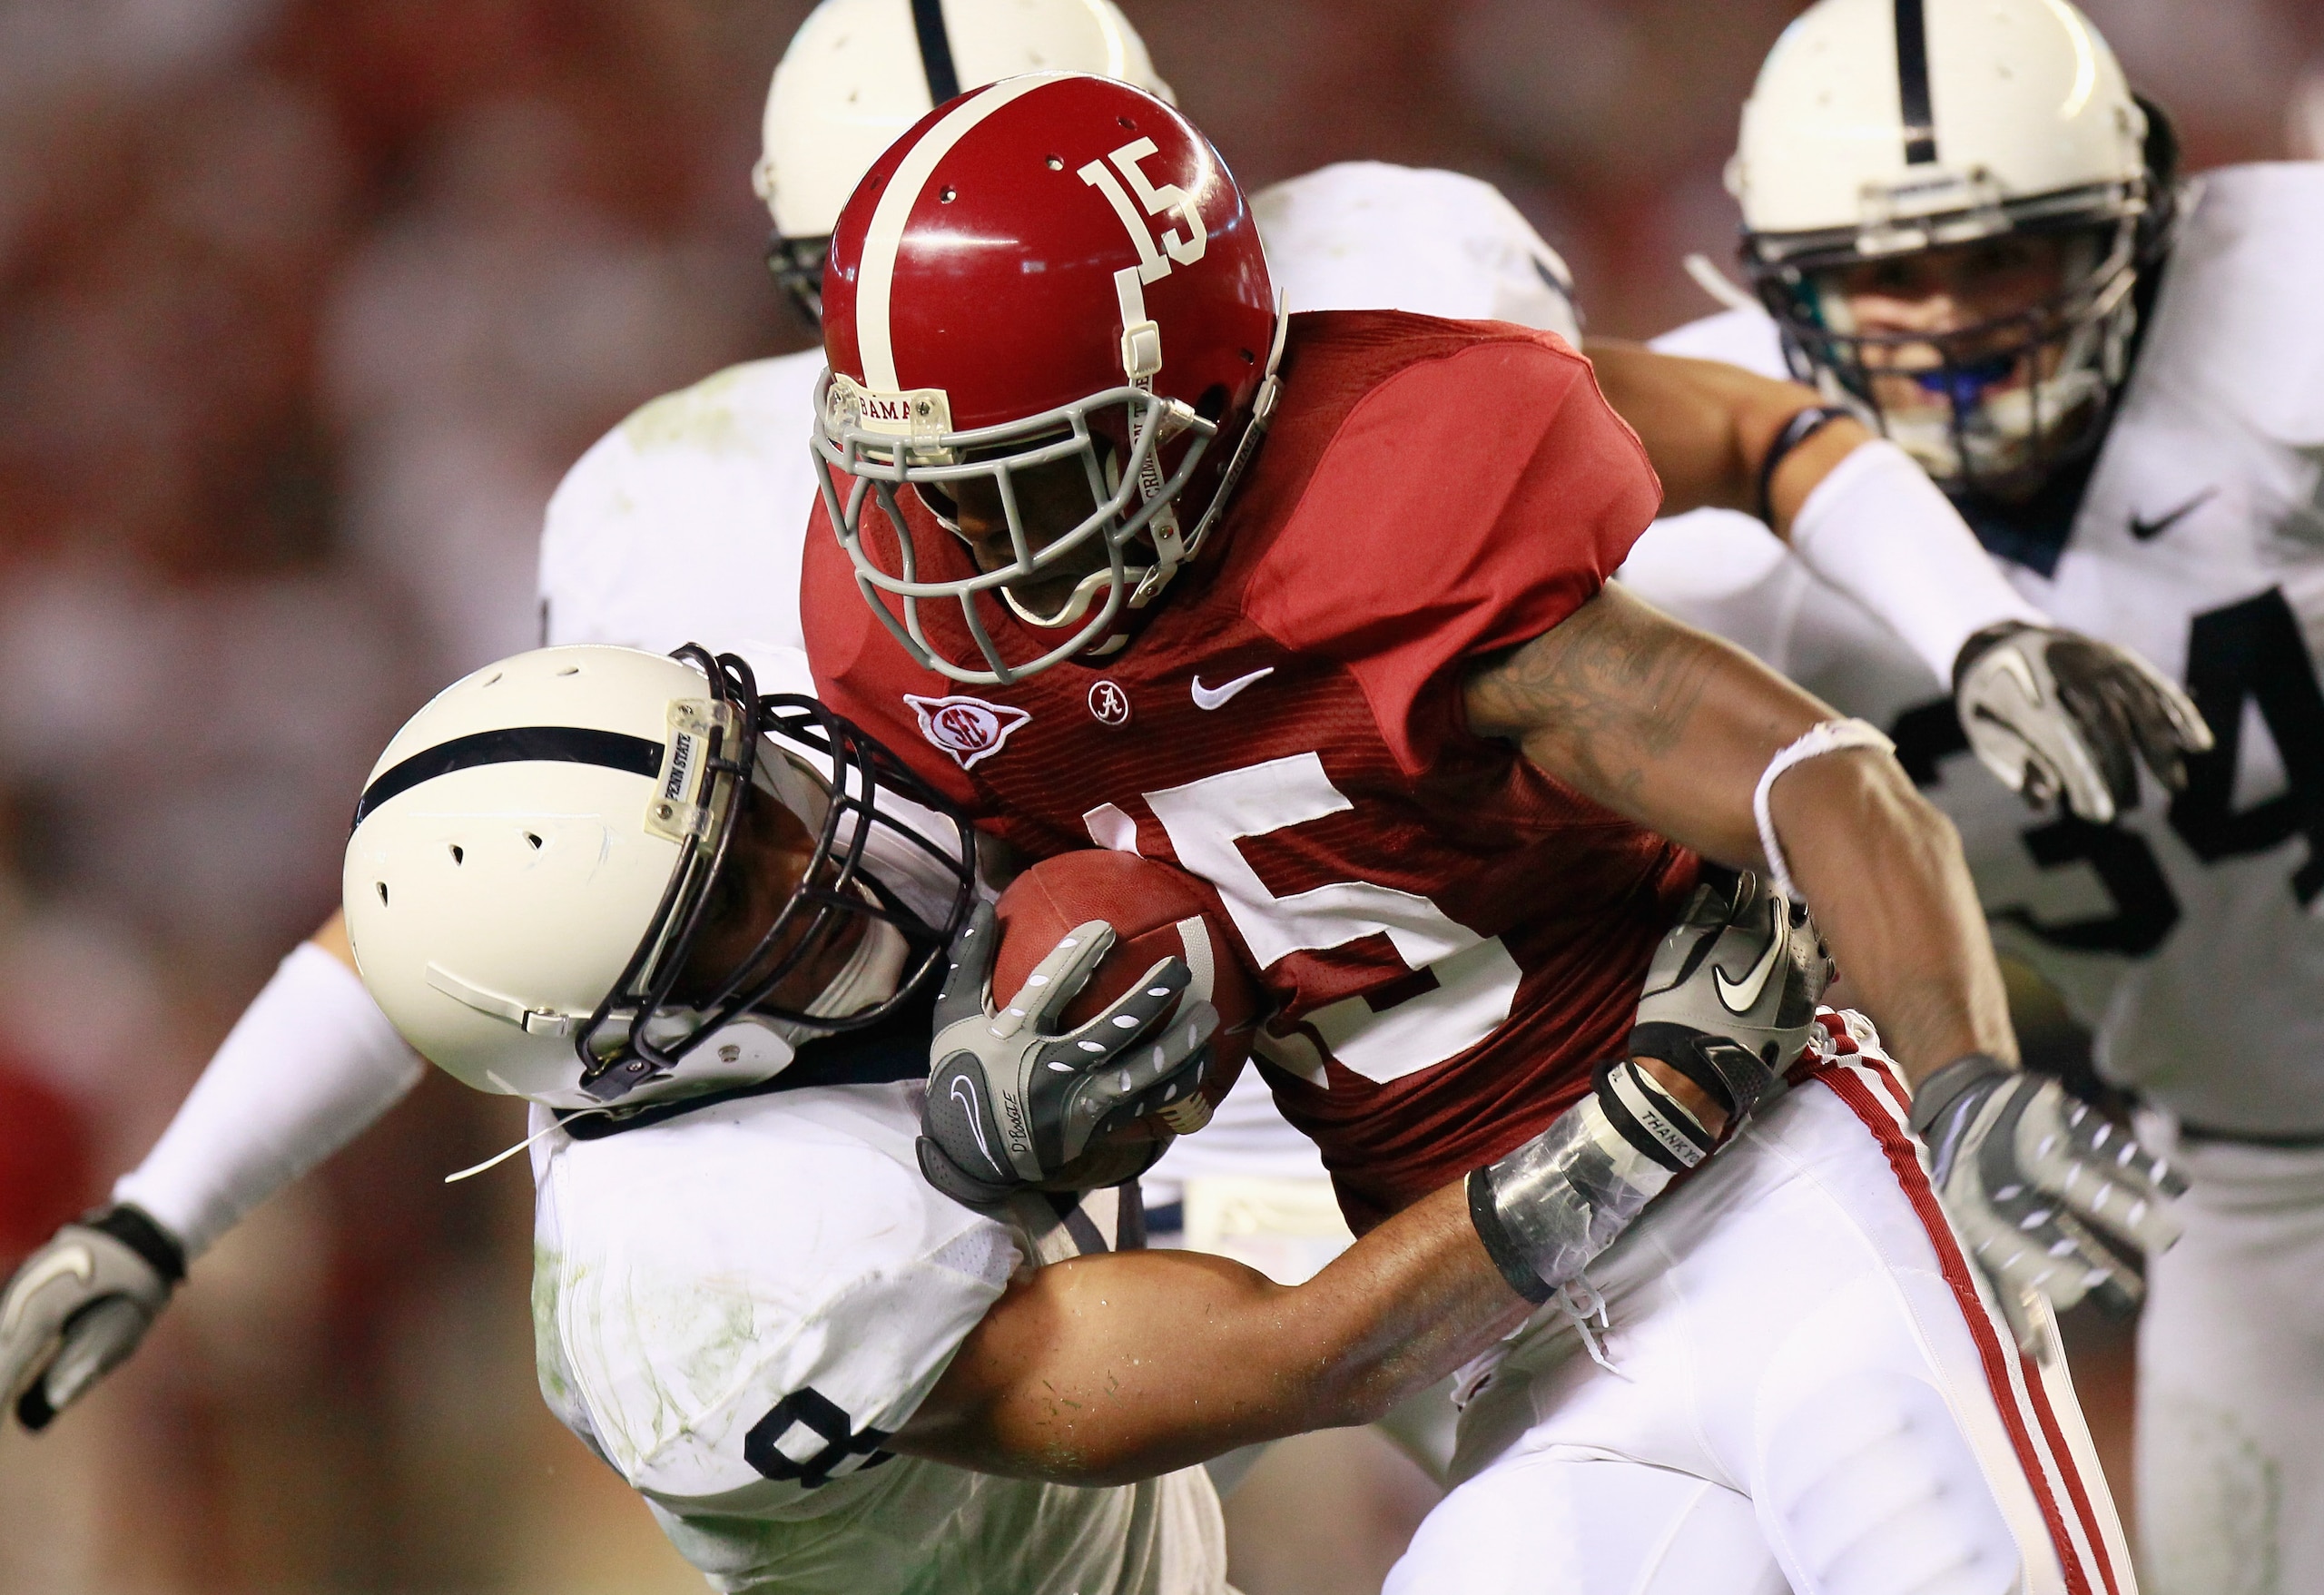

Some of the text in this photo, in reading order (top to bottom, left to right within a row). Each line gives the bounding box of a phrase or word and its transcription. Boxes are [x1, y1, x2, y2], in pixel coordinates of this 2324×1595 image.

[1077, 136, 1207, 285] 15
[941, 708, 988, 748] SEC
[665, 732, 691, 802] PENN STATE
[1642, 1110, 1689, 1153] THANK
